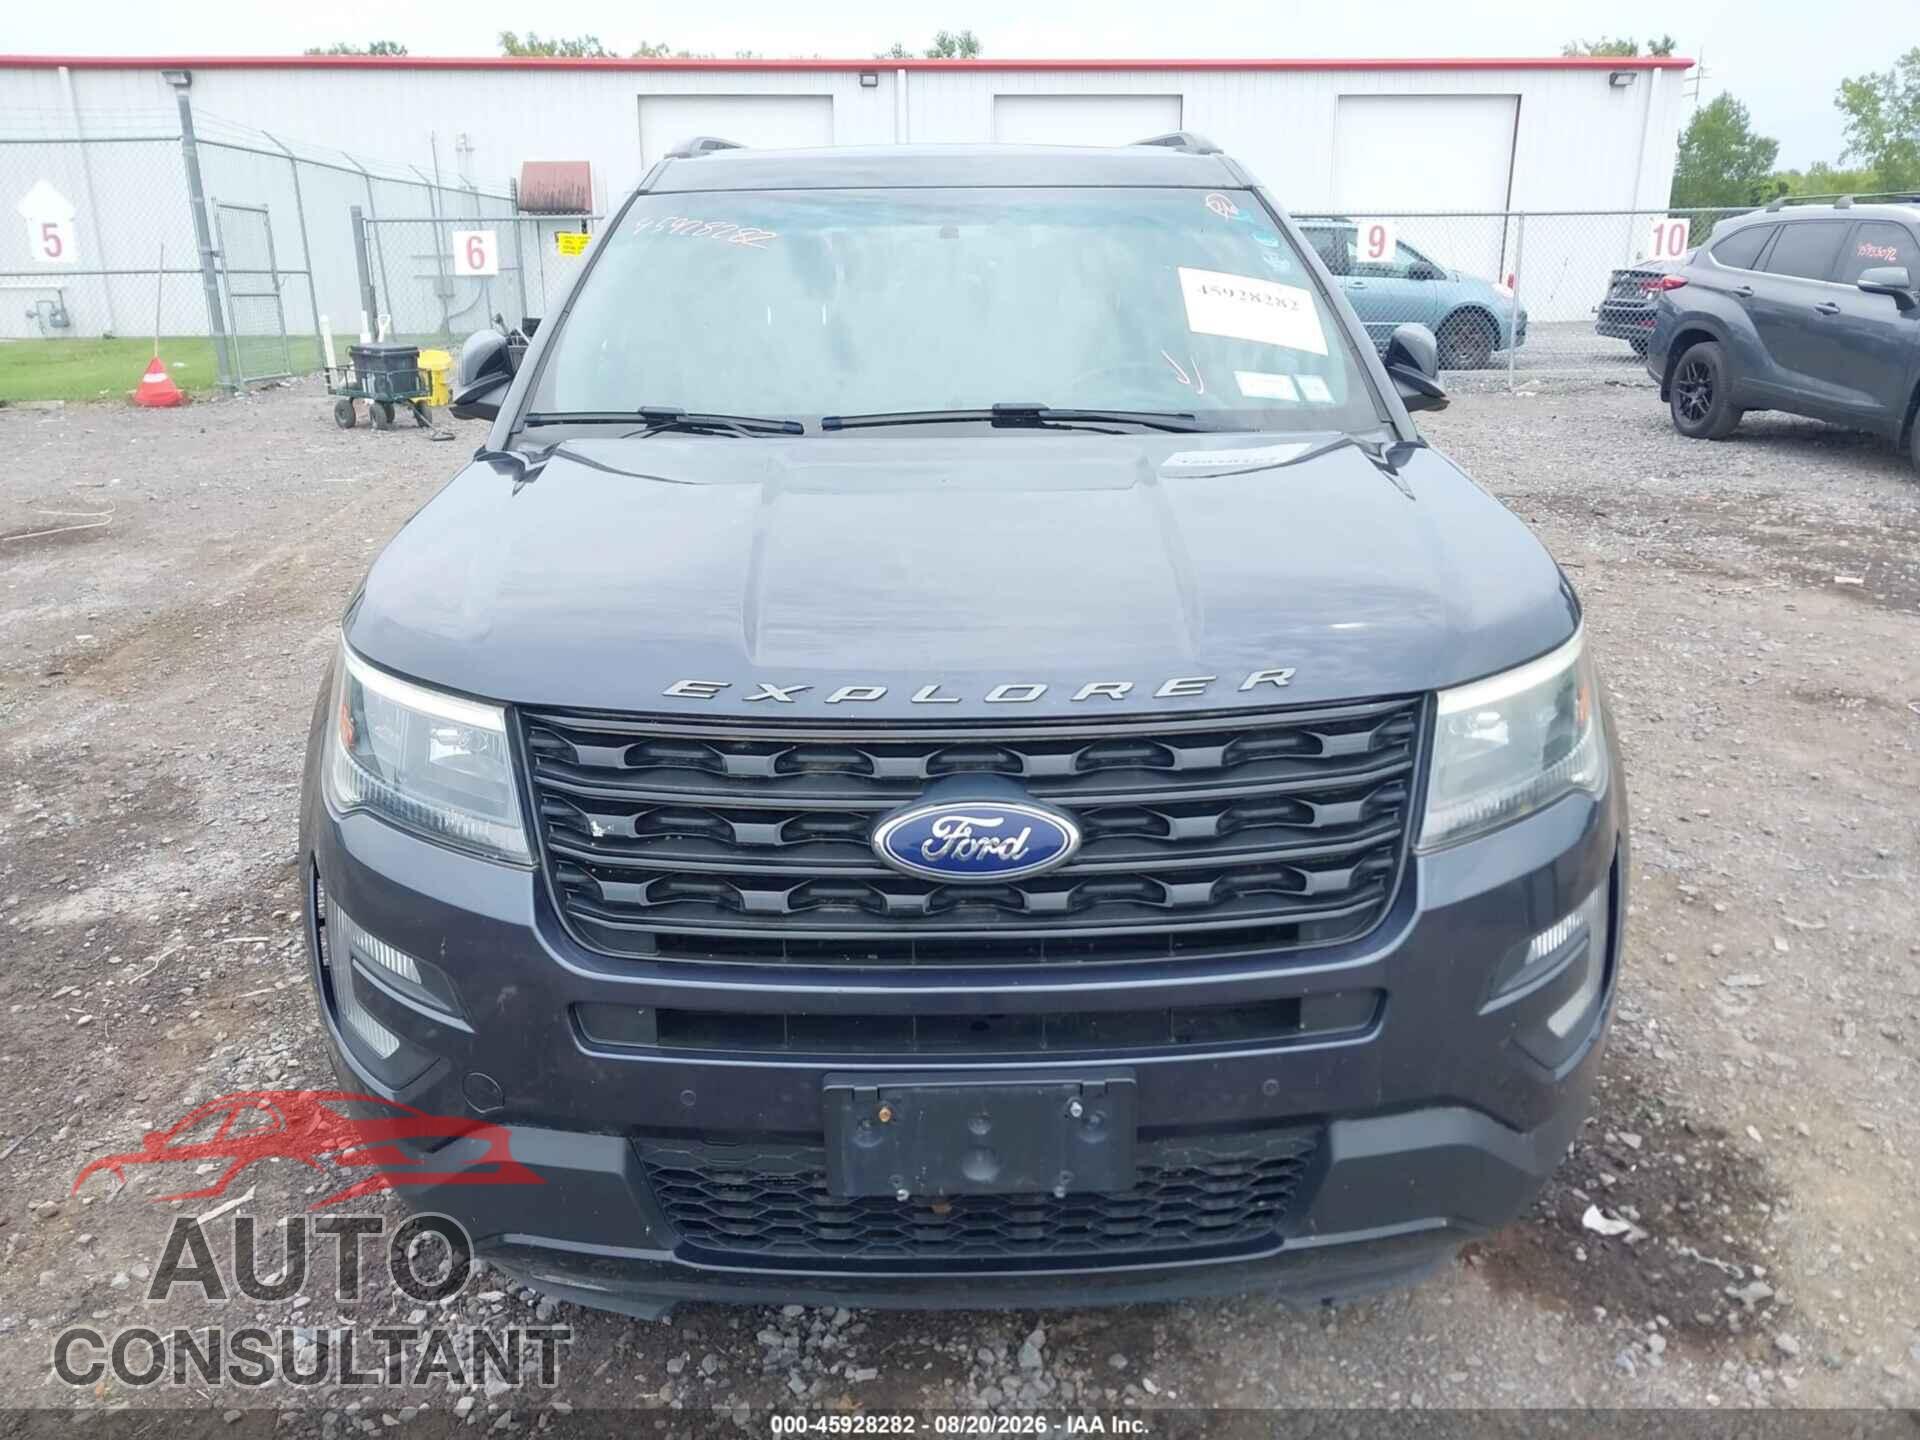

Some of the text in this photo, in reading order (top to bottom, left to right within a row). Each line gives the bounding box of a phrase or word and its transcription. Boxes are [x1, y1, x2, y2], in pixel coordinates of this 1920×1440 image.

[42, 222, 62, 257] 5
[466, 236, 485, 270] 6
[1368, 225, 1386, 258] 9
[1653, 223, 1685, 256] 10
[1198, 284, 1301, 312] 45928282
[661, 666, 1297, 704] EXPLORER
[921, 815, 1032, 861] Ford
